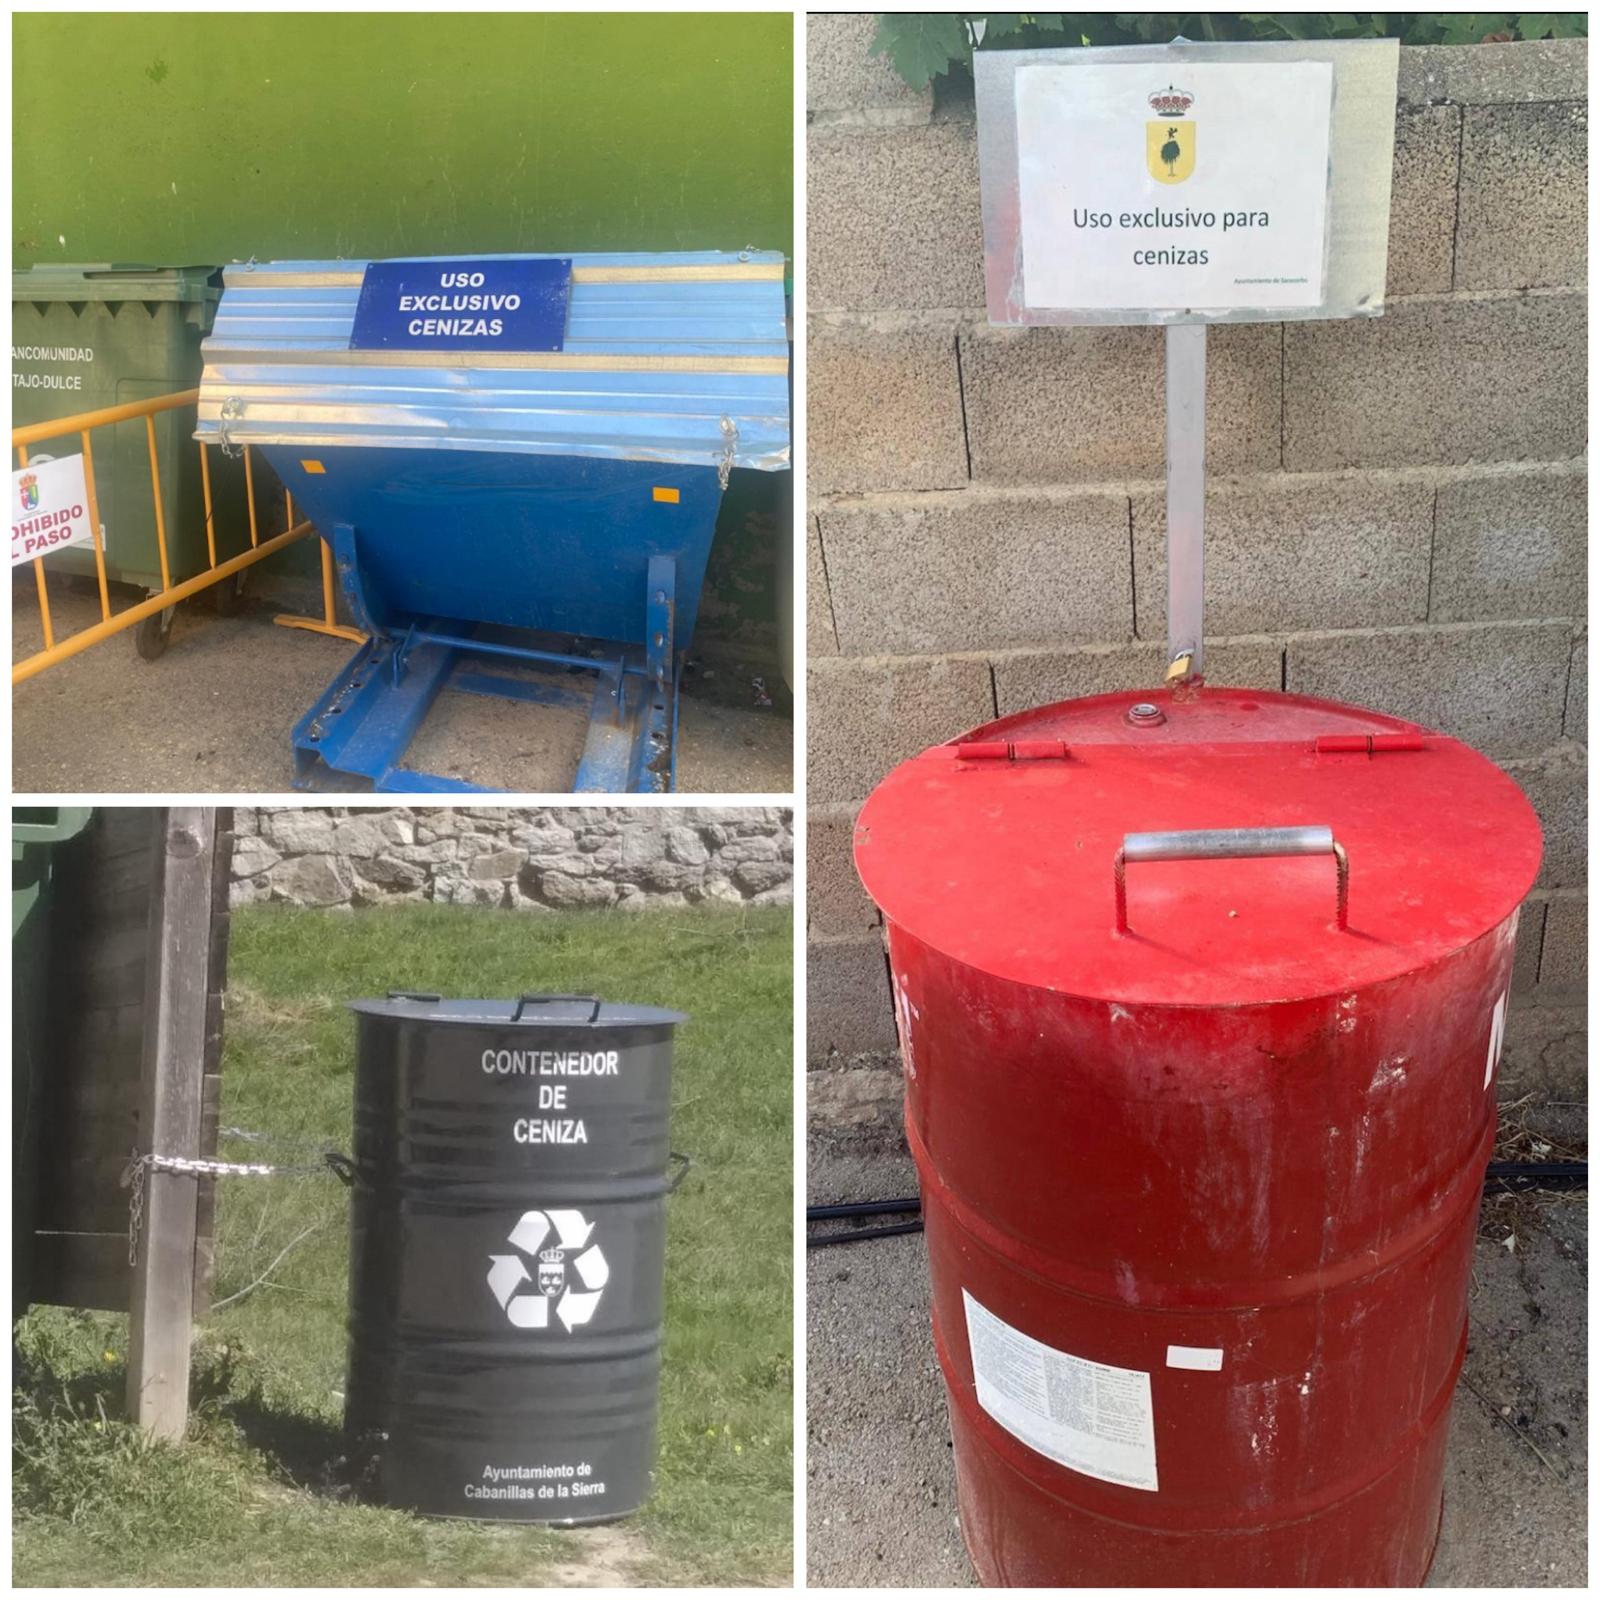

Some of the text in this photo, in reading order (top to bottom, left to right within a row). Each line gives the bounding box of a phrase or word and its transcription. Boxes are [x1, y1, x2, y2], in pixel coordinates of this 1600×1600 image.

[1073, 207, 1269, 232] Uso exclusivo para
[1133, 245, 1209, 265] cenizas
[440, 272, 485, 288] USO
[399, 294, 521, 311] EXCLUSIVO
[408, 318, 503, 336] CENIZAS
[13, 373, 82, 390] TAJO-DULCE
[24, 526, 72, 554] PASO
[481, 1049, 619, 1076] CONTENEDOR
[538, 1084, 567, 1109] DE
[513, 1118, 588, 1143] CENIZA
[482, 1461, 592, 1482] Ayuntamiento de
[464, 1481, 606, 1499] Cabanillas de la Sierra
